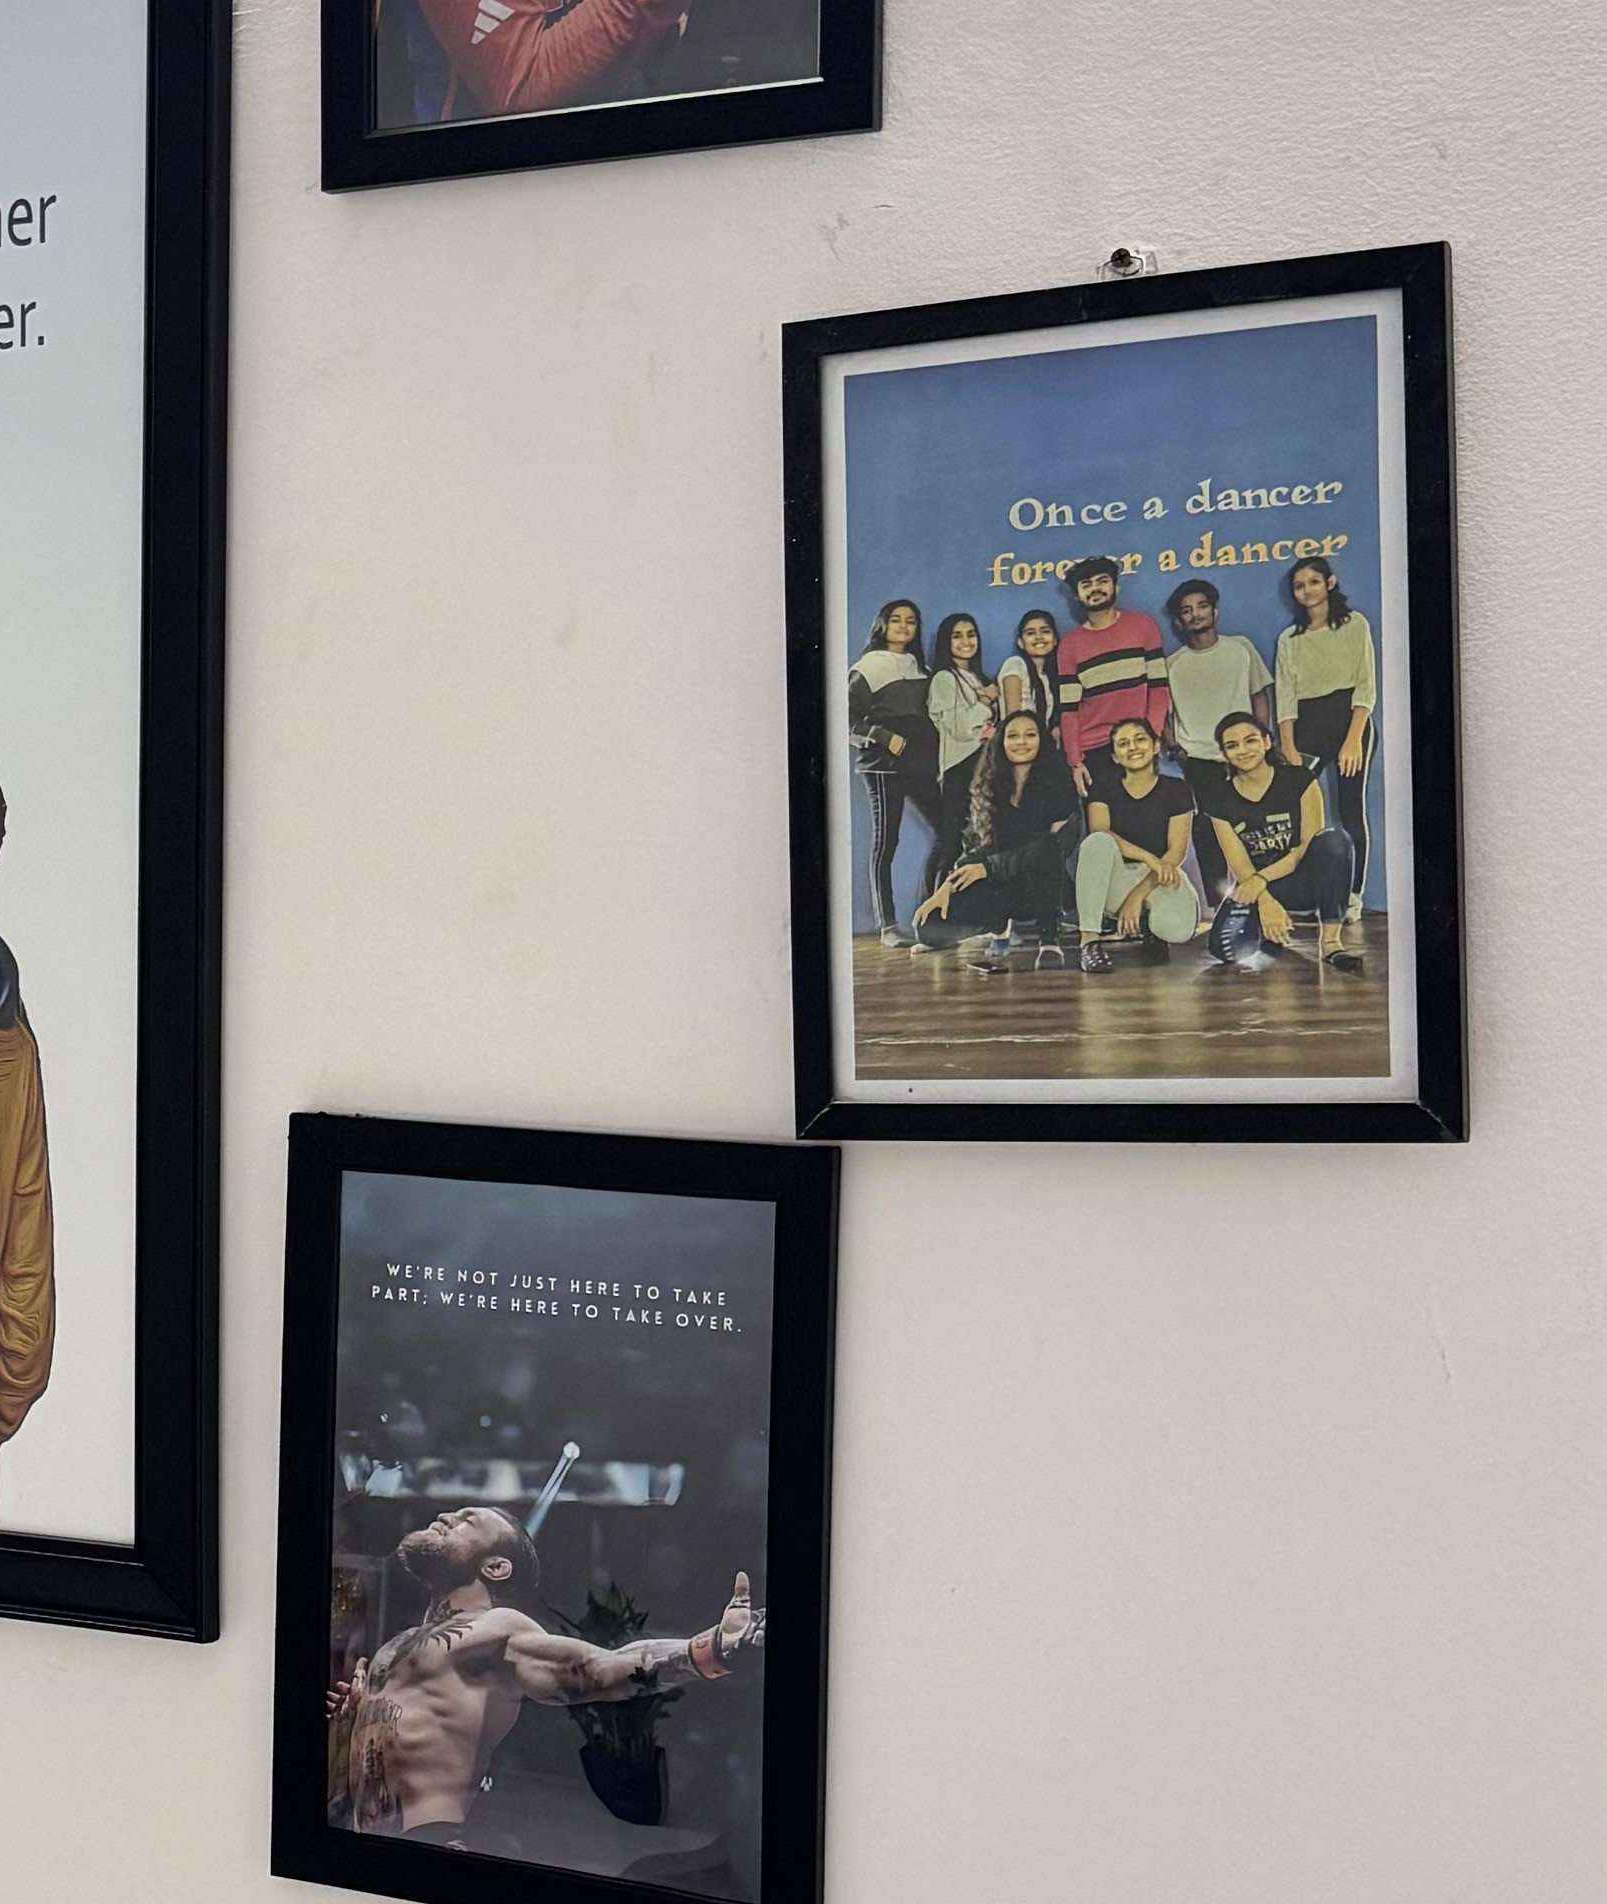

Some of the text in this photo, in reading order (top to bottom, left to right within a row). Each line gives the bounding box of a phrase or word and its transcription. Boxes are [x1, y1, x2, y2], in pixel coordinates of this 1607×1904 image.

[1008, 477, 1344, 531] Once a dancer
[986, 530, 1349, 587] forer a dancer
[371, 1285, 742, 1333] PART; WE'RE HERE TO TAKE OVER.
[386, 1262, 726, 1306] WE'RE NOT JUST HERE TO TAKE
